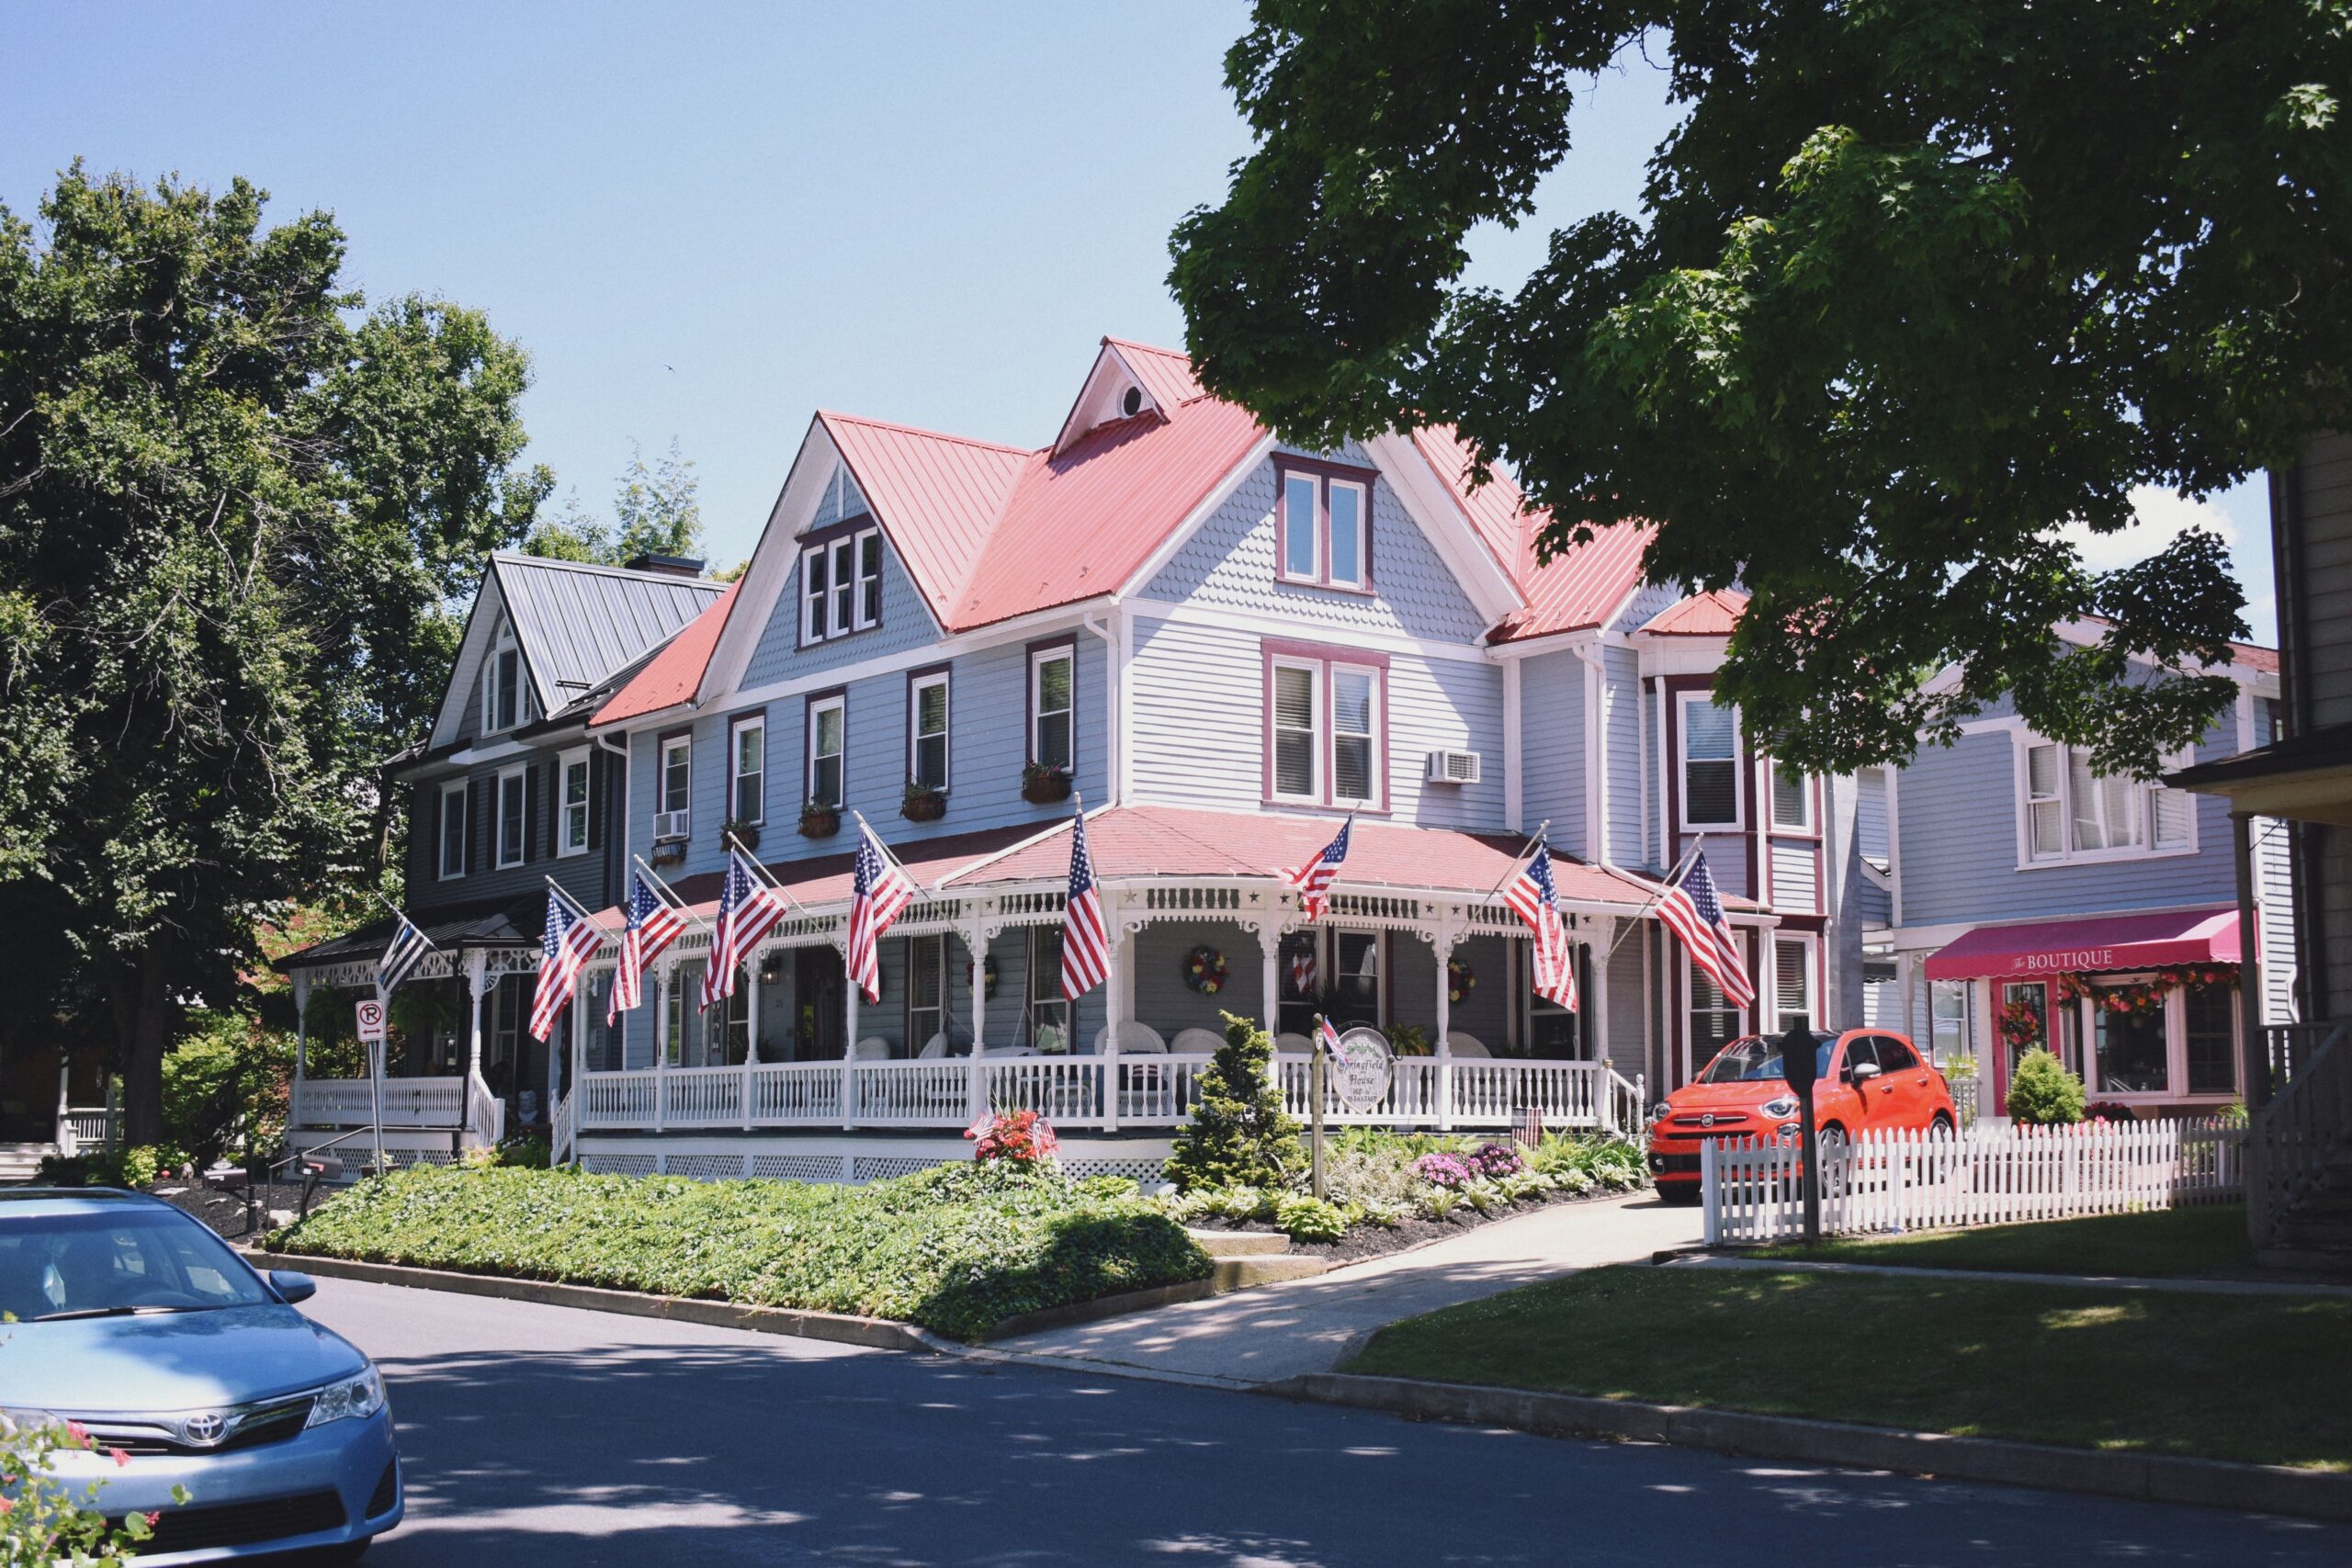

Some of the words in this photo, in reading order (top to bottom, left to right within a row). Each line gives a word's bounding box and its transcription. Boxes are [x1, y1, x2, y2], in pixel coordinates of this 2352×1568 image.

[2010, 957, 2025, 970] The
[2027, 950, 2112, 969] BOUTIQUE
[1349, 1074, 1374, 1085] House
